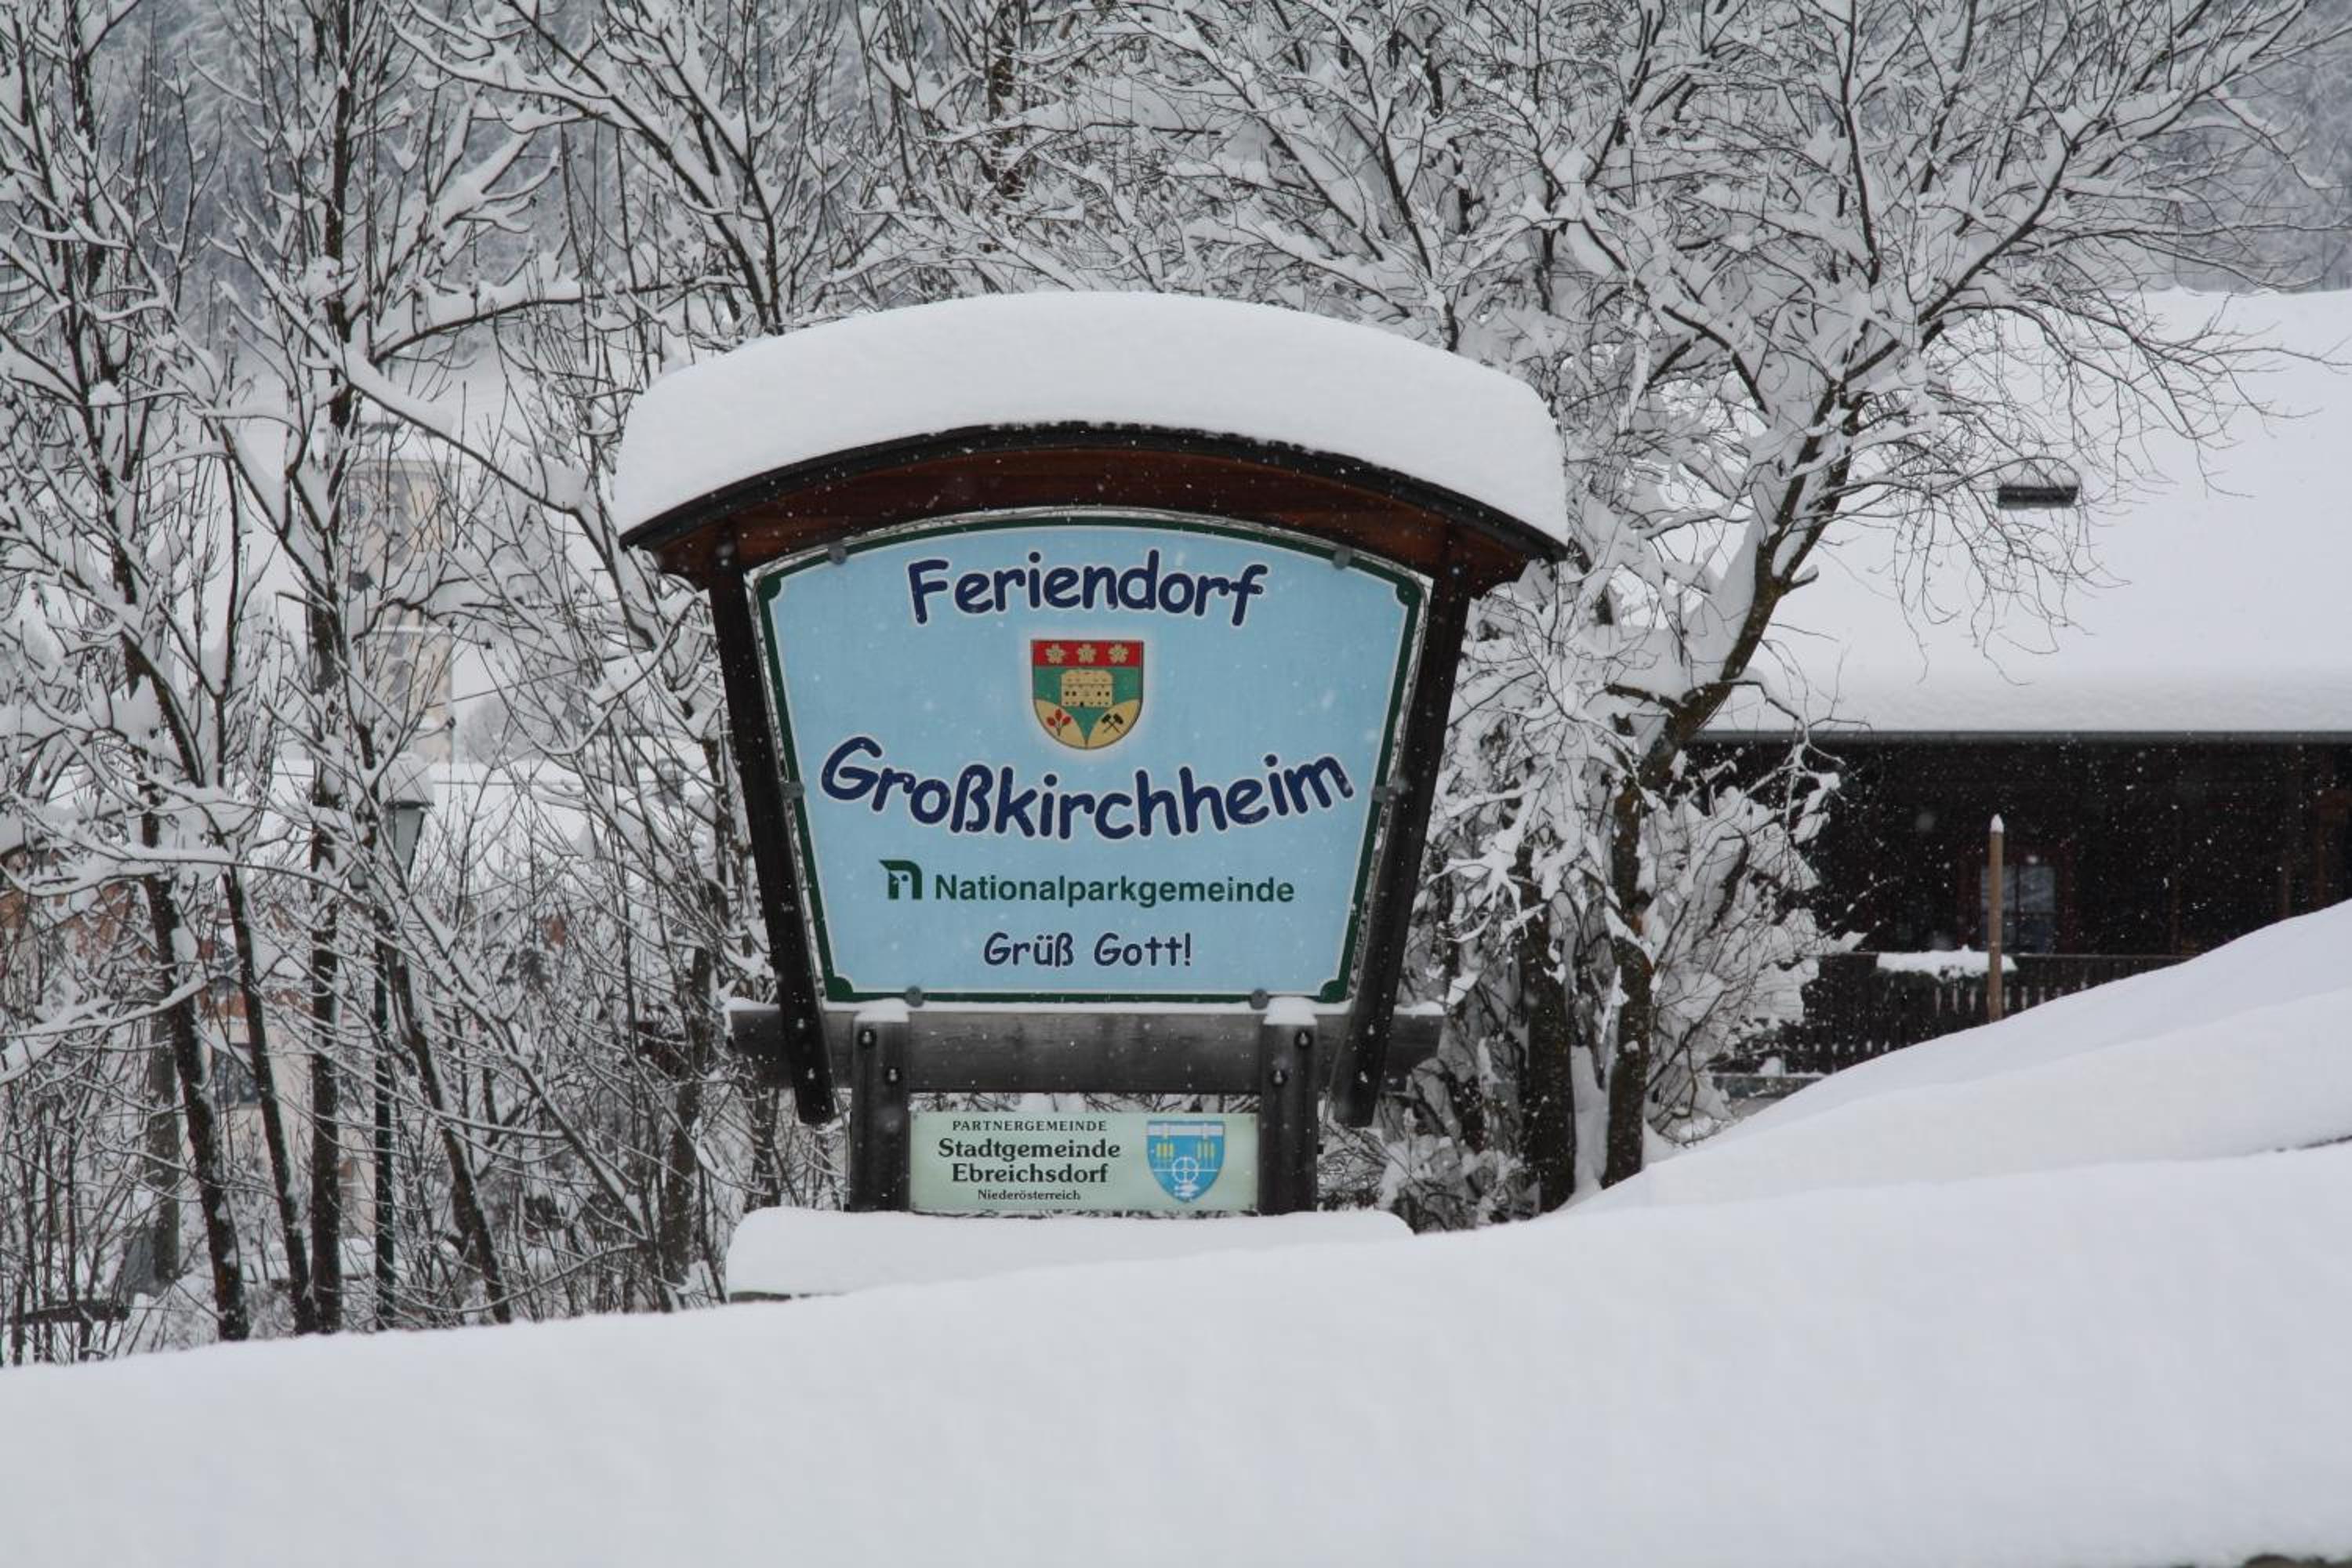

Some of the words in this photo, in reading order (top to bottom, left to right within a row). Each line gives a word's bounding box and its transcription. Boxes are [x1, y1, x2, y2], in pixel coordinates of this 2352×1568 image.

[907, 550, 1268, 626] Feriendorf
[821, 736, 1355, 840] Großkirchheim
[935, 873, 1295, 908] Nationalparkgemeinde
[984, 932, 1074, 967] Grüß
[1093, 932, 1192, 967] Gott!
[953, 1120, 1107, 1132] PARTNERGEMEINDE
[938, 1138, 1121, 1162] Stadtgemeinde
[952, 1163, 1109, 1183] Ebreichsdorf
[978, 1189, 1081, 1201] Niederösterreich
